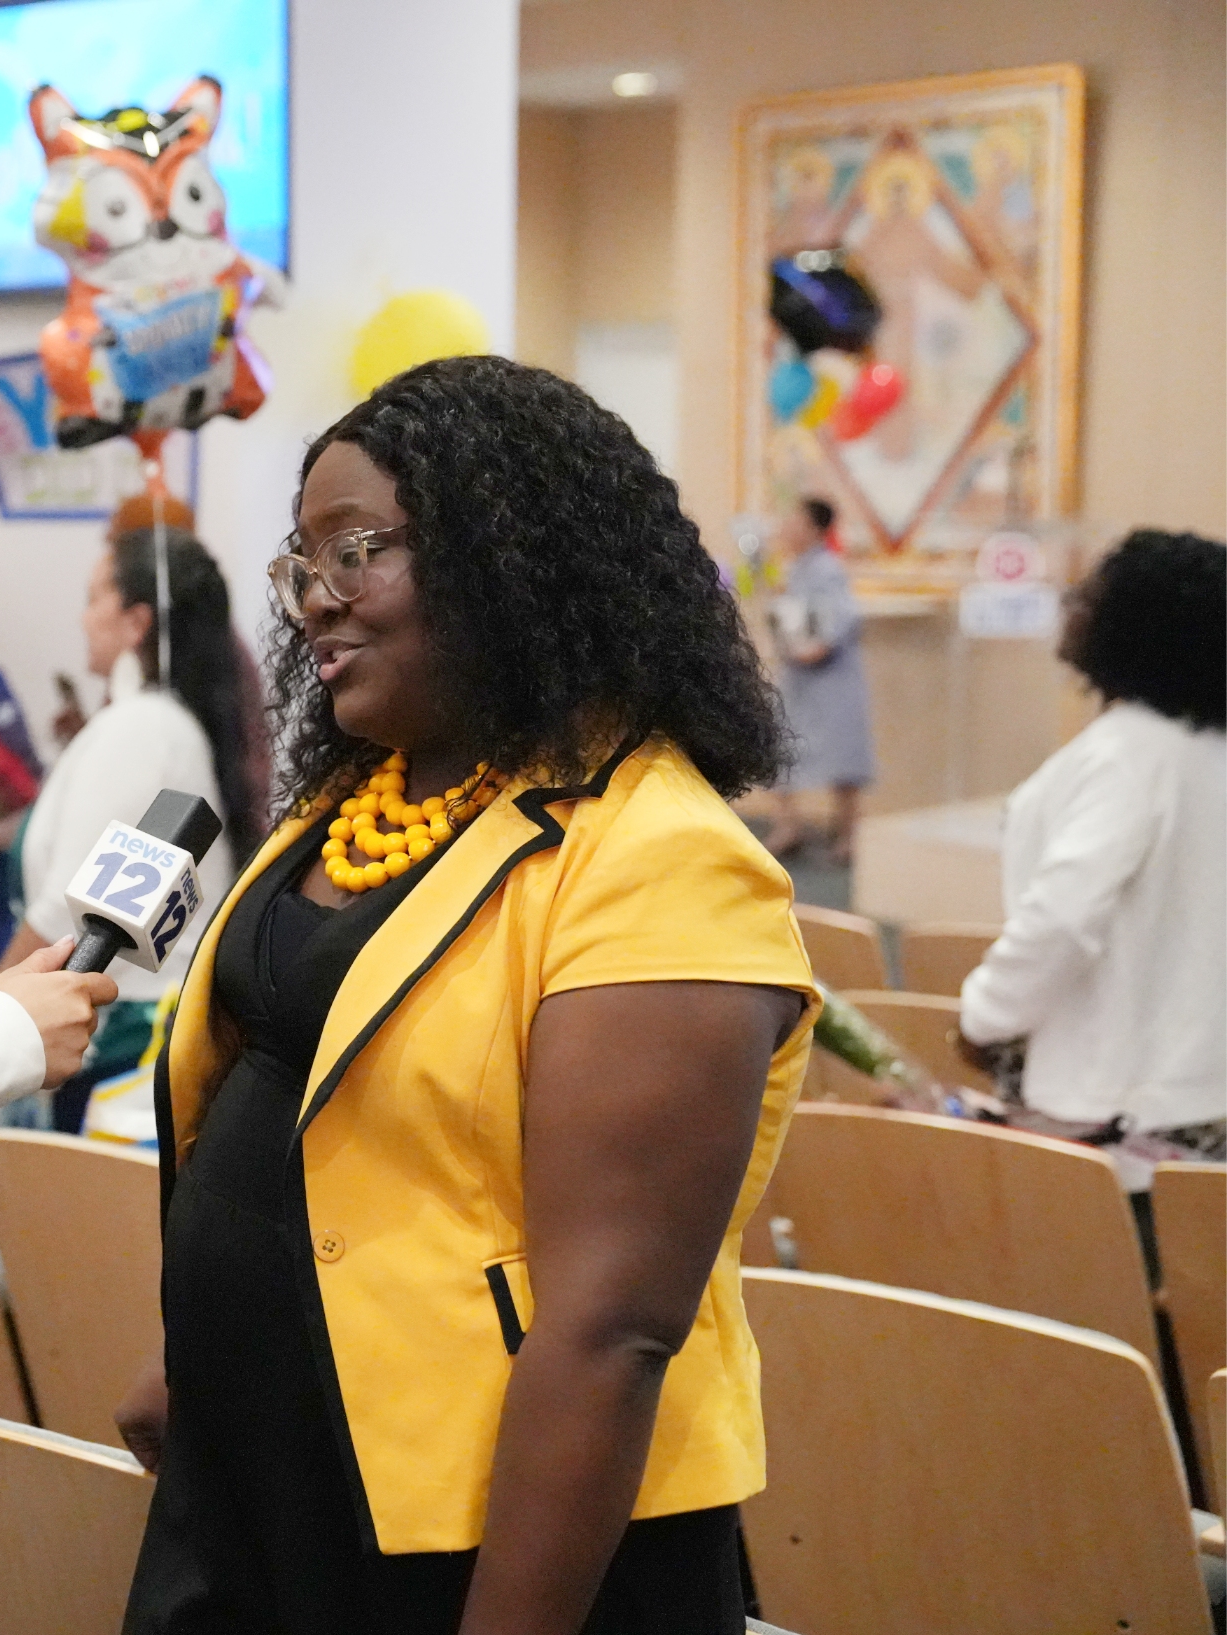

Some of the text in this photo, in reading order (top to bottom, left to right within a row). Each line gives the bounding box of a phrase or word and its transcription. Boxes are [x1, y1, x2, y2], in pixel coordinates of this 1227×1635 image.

[109, 829, 177, 869] news
[85, 851, 162, 918] 12
[180, 867, 199, 914] news
[150, 890, 187, 963] 12
